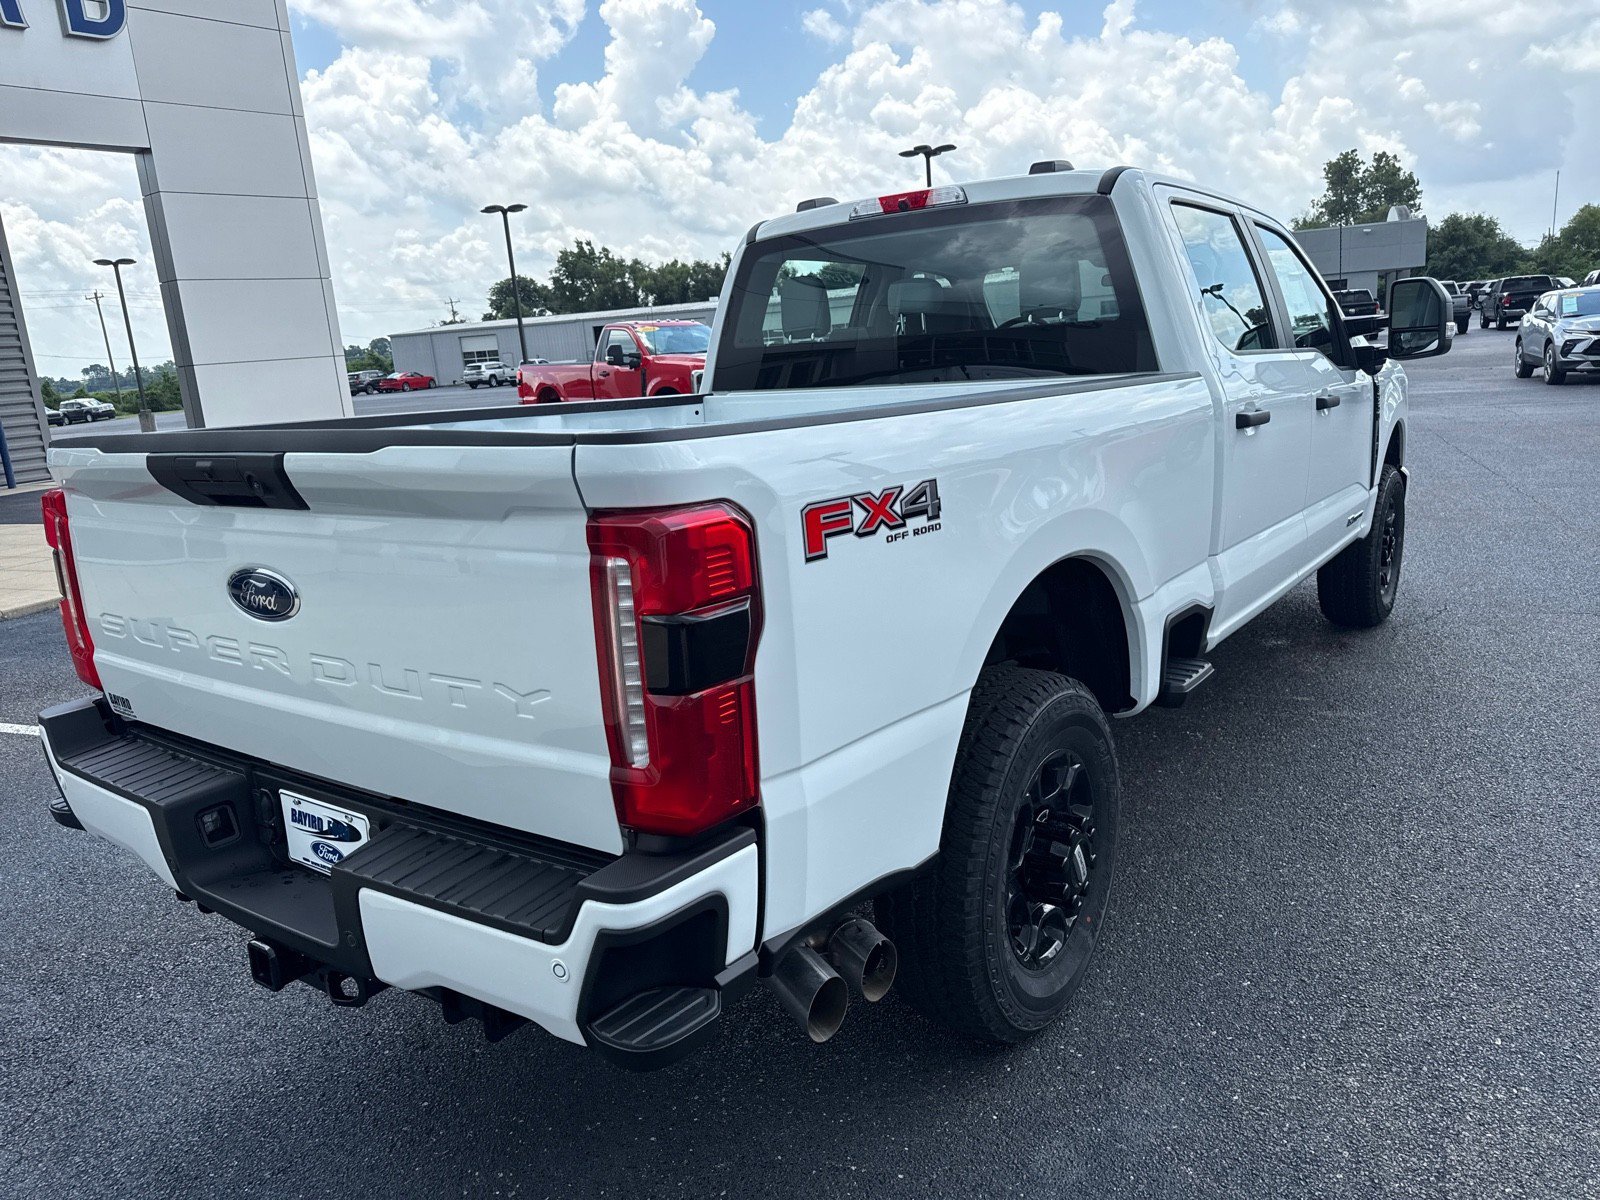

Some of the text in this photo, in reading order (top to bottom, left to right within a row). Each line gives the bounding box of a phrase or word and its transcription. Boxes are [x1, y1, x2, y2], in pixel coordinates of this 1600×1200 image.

[800, 477, 942, 565] FX4
[886, 522, 942, 544] OFF ROAD
[240, 579, 278, 611] Ford
[100, 611, 552, 720] SUPER DUTY
[290, 807, 324, 832] BAYIRD
[317, 843, 340, 863] Ford
